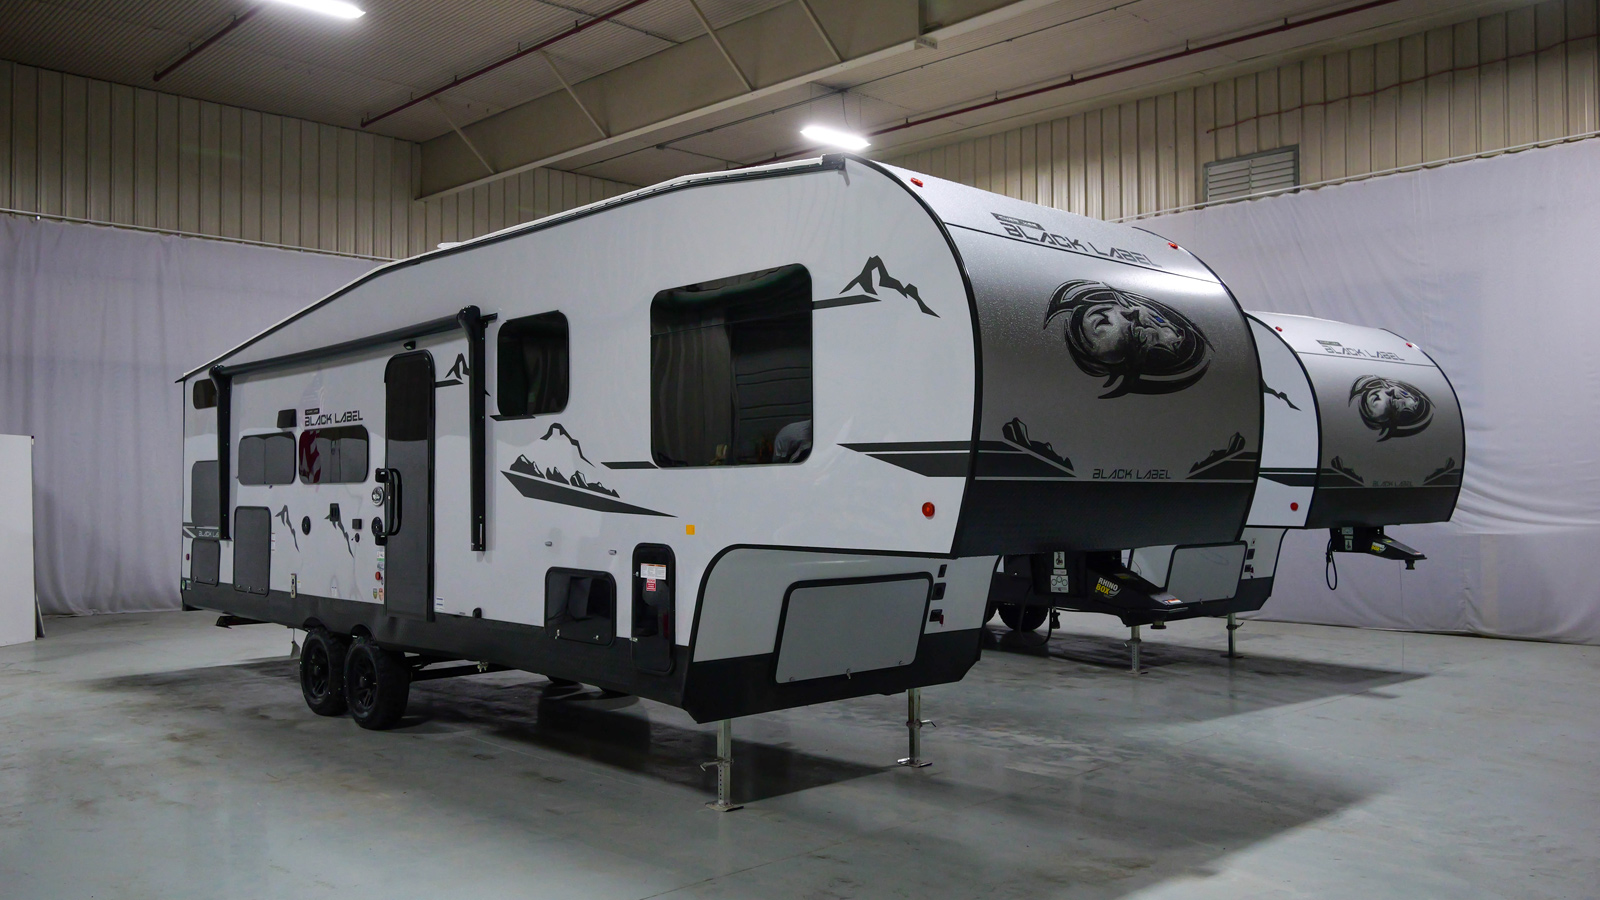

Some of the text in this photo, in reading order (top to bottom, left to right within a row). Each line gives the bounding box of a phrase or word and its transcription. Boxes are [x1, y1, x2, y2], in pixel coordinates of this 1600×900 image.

[1000, 222, 1162, 268] BLACK LABEL
[1322, 345, 1405, 361] BLACK LABEL
[304, 413, 332, 427] BLACK
[335, 410, 363, 424] LABEL
[1092, 468, 1171, 480] BLACK LABEL
[1095, 583, 1110, 595] BOX
[1098, 577, 1119, 591] RHINO
